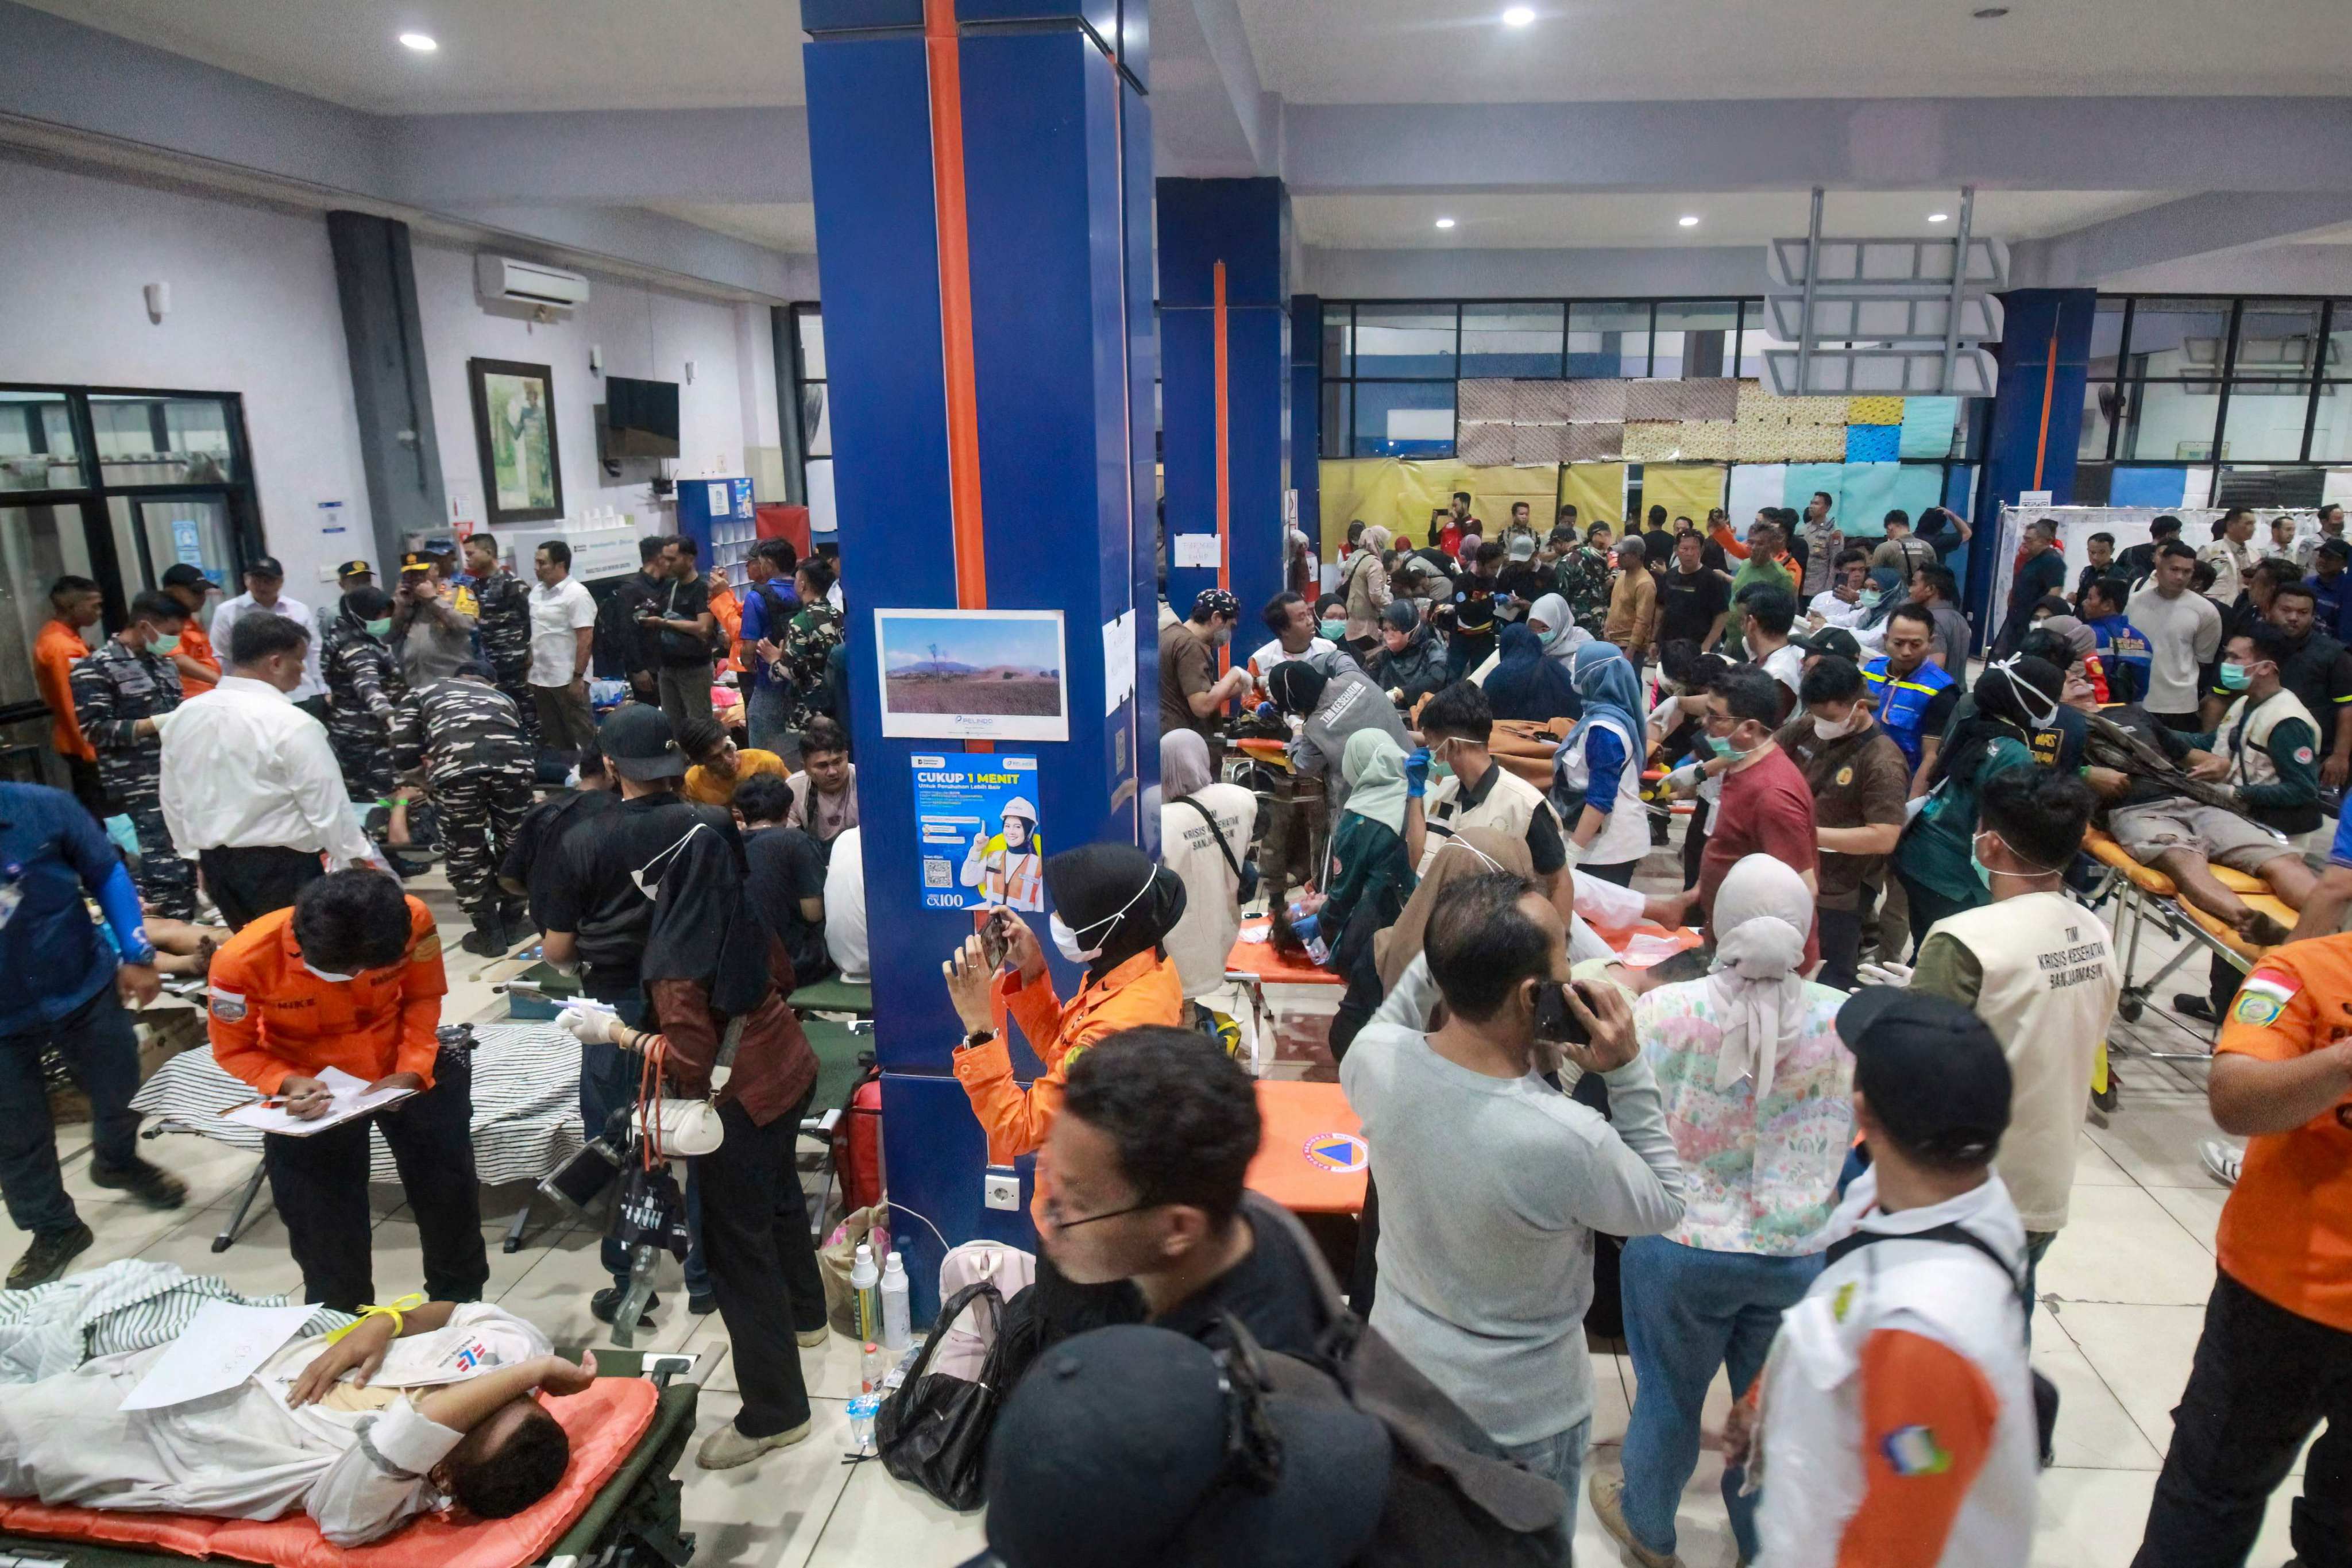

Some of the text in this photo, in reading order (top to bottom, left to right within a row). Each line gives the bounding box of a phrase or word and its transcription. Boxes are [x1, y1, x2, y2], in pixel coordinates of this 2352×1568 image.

[917, 772, 1020, 785] CUKUP 1 MENIT
[2065, 926, 2079, 943] TIM
[2037, 941, 2105, 971] KRISIS KESEHATAN
[2049, 963, 2103, 989] BANJARMASIN
